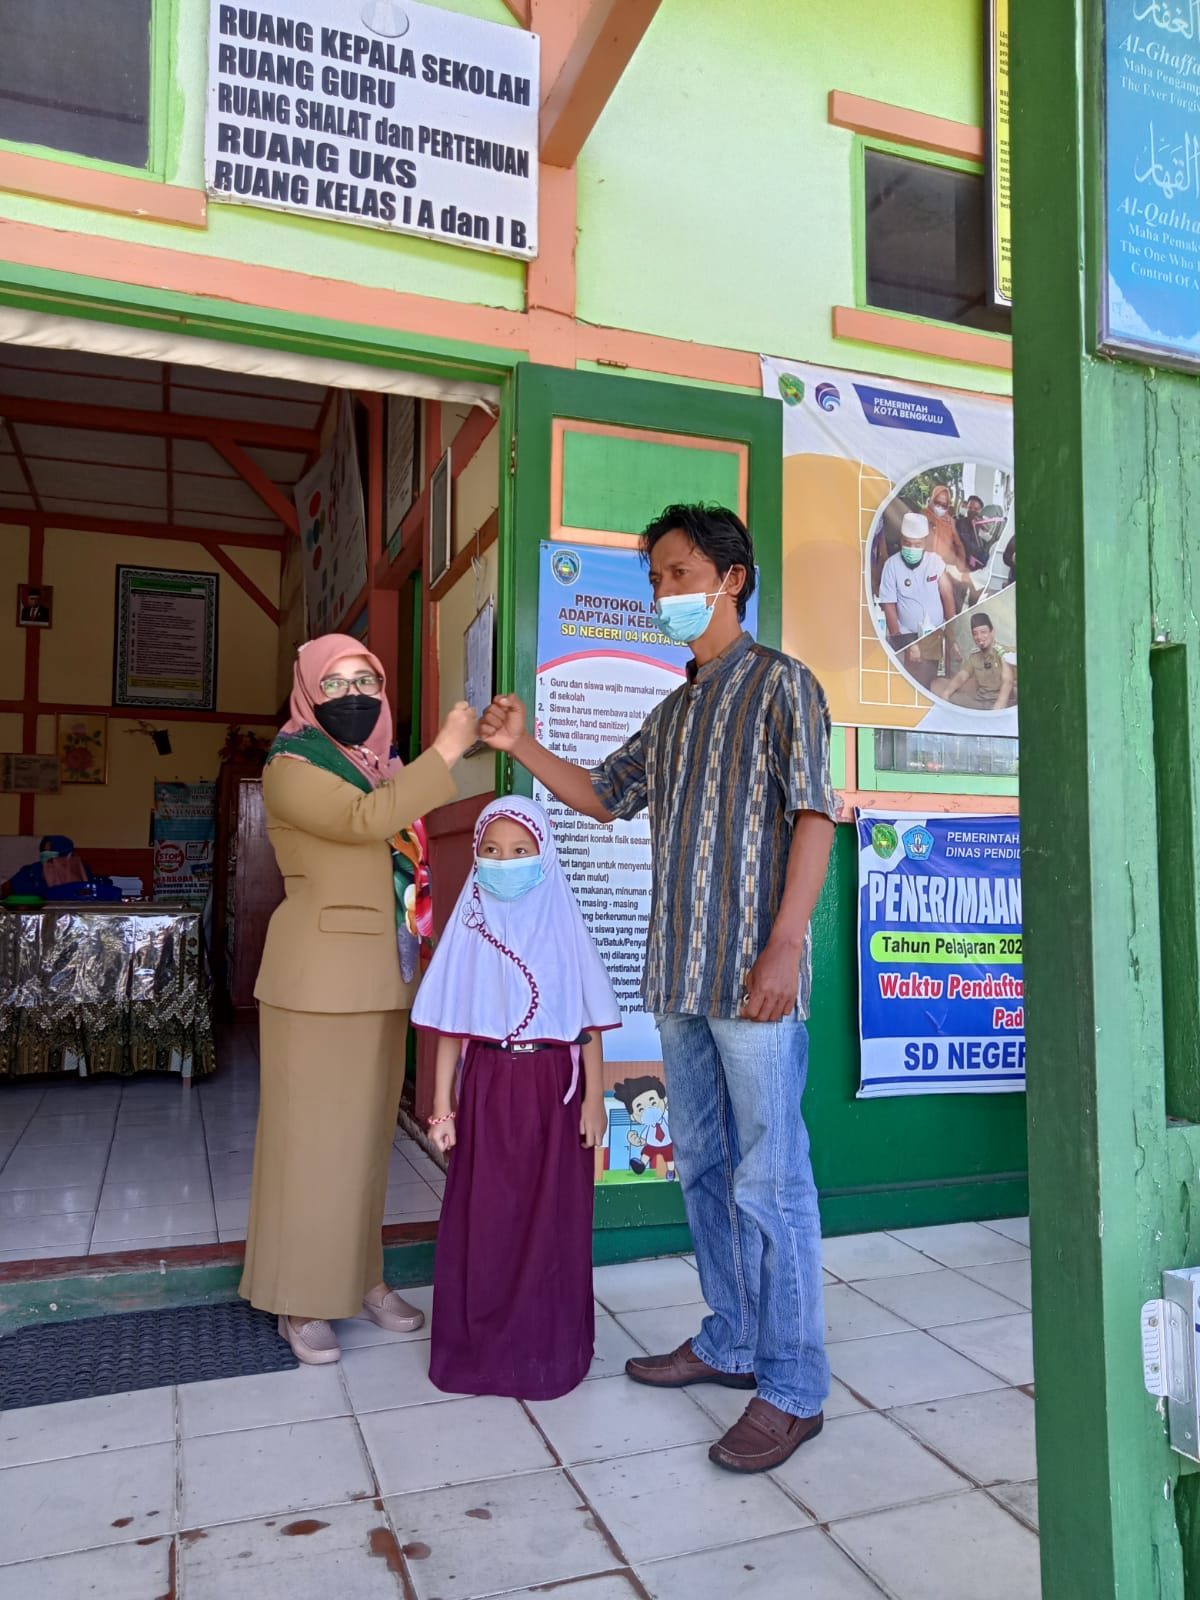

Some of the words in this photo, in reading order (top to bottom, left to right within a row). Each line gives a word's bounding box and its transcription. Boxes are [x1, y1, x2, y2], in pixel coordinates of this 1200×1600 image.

[220, 4, 313, 52] RUANG
[321, 27, 416, 78] KEPALA
[422, 54, 530, 106] SEKOLAH
[1124, 57, 1152, 78] Maha
[219, 43, 314, 91] RUANG
[322, 66, 395, 109] GURU
[1120, 75, 1140, 92] The
[1144, 83, 1168, 101] Ever
[218, 82, 290, 124] RUANG
[296, 98, 370, 141] SHALAT
[375, 116, 414, 151] dan
[419, 126, 528, 178] PERTEMUAN
[218, 122, 339, 174] RUANG
[350, 149, 416, 188] UKS
[215, 160, 309, 205] RUANG
[316, 178, 396, 221] KELAS
[403, 196, 411, 223] I
[418, 200, 434, 229] A
[441, 206, 489, 241] dan
[496, 215, 504, 244] I
[512, 220, 527, 249] B
[1129, 223, 1158, 242] Maha
[1120, 240, 1141, 256] The
[1144, 246, 1166, 262] One
[1169, 253, 1194, 270] Who
[1131, 261, 1172, 284] Control
[1175, 274, 1189, 288] Of
[874, 398, 928, 412] PEMERINTAH
[874, 406, 898, 416] KOTA
[900, 411, 944, 424] BENGKULU
[576, 594, 646, 613] PROTOKOL
[558, 608, 623, 626] ADAPTASI
[561, 624, 576, 636] SD
[580, 626, 622, 640] NEGERI
[625, 630, 638, 642] 04
[642, 633, 670, 646] KOTA
[550, 678, 568, 688] Guru
[570, 680, 582, 688] dan
[584, 680, 603, 690] siswa
[605, 682, 623, 694] wajib
[558, 692, 584, 702] sekolah
[550, 704, 570, 714] Siswa
[572, 706, 592, 715] harus
[593, 708, 628, 718] membawa
[549, 718, 579, 729] (masker,
[580, 719, 597, 728] hand
[599, 720, 629, 731] sanitizer)
[549, 729, 570, 738] Siswa
[571, 730, 599, 742] dilarang
[549, 742, 560, 751] alat
[562, 743, 577, 752] tulis
[546, 808, 562, 820] guru
[577, 821, 614, 832] Distancing
[590, 834, 614, 844] kontak
[615, 835, 629, 844] fisik
[947, 832, 1019, 844] PEMERINTAH
[946, 847, 980, 858] DINAS
[571, 860, 596, 870] tangan
[596, 861, 616, 870] untuk
[572, 872, 586, 881] dan
[587, 874, 609, 883] mulut)
[580, 886, 614, 896] makanan,
[616, 887, 647, 896] minuman
[868, 872, 1022, 925] PENERIMAAN
[582, 899, 608, 909] masing
[613, 900, 638, 910] masing
[595, 912, 636, 922] berkerumun
[595, 925, 614, 934] siswa
[616, 926, 632, 936] yang
[882, 936, 930, 954] Tahun
[936, 938, 994, 958] Pelajaran
[612, 952, 640, 962] dilarang
[880, 973, 941, 998] Waktu
[904, 1042, 938, 1070] SD
